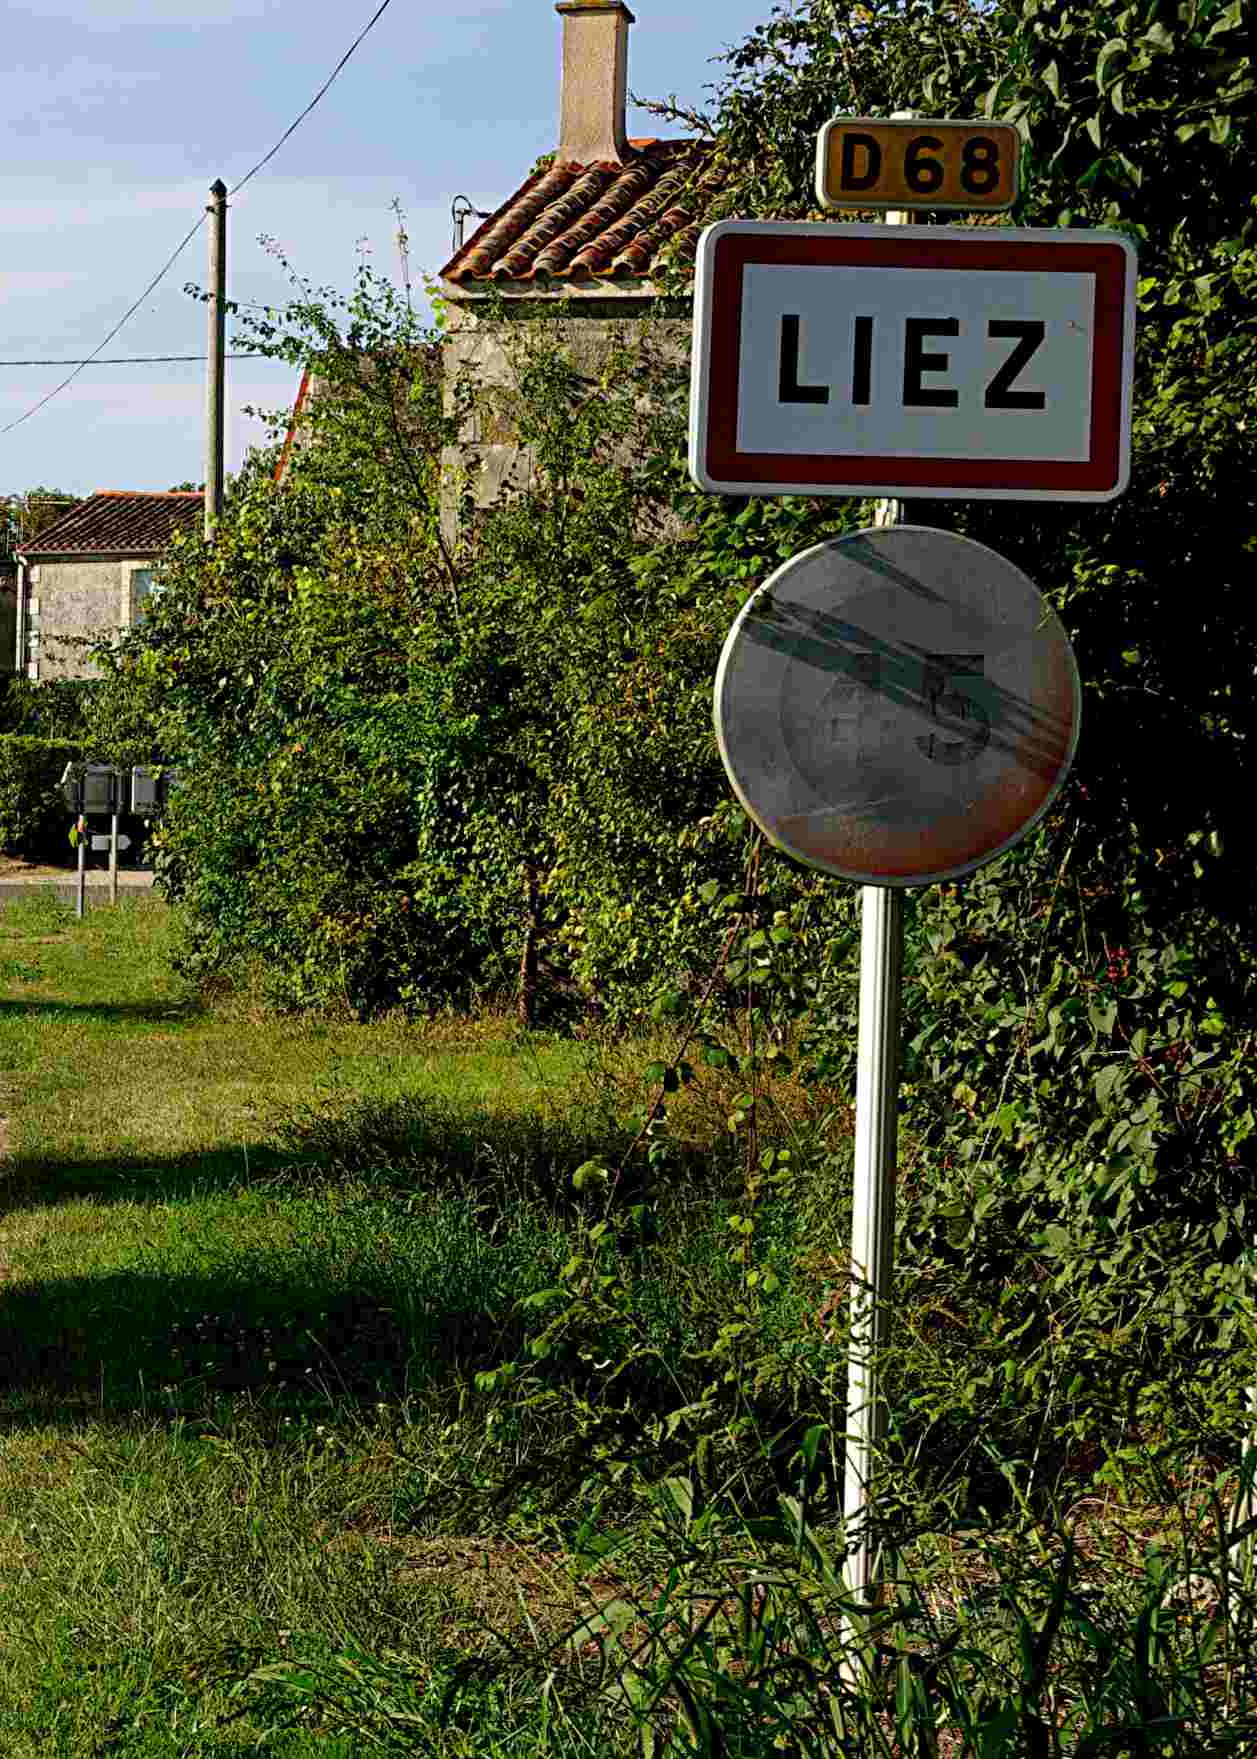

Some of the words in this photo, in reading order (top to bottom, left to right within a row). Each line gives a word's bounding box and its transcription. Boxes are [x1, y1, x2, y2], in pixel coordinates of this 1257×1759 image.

[841, 133, 882, 191] D
[903, 135, 1001, 194] 68
[777, 314, 1046, 410] LIEZ
